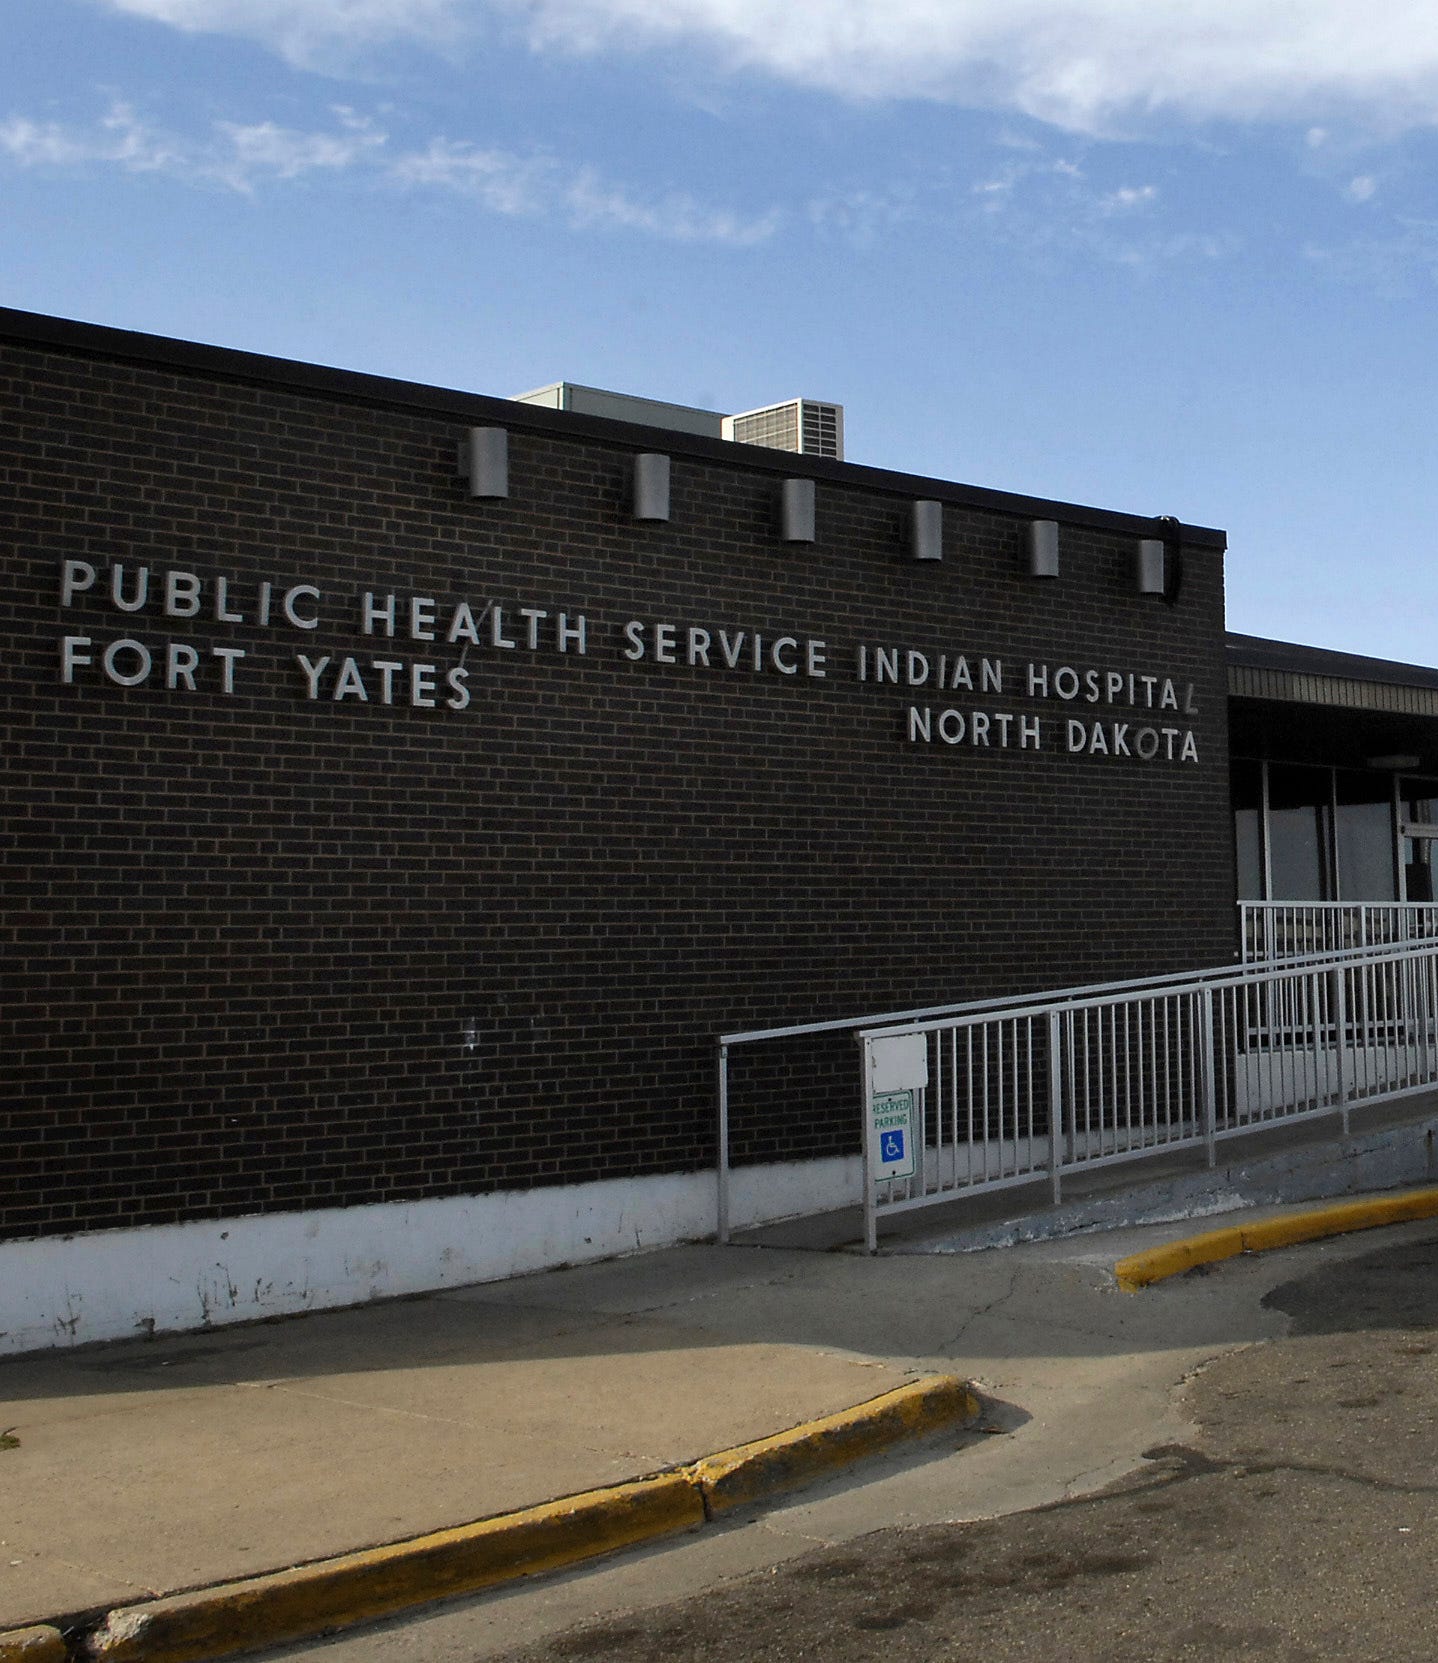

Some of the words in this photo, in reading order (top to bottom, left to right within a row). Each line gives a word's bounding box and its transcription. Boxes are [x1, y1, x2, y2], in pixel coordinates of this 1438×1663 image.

[62, 560, 321, 630] PUBLIC
[363, 592, 586, 655] HEALTH
[623, 620, 827, 678] SERVICE
[857, 645, 1002, 693] INDIAN
[1028, 663, 1199, 716] HOSPITAL
[61, 636, 246, 694] FORT
[297, 654, 471, 710] YATES
[908, 706, 1041, 751] NORTH
[1067, 718, 1199, 764] DAKOTA
[874, 1114, 908, 1129] PARKING
